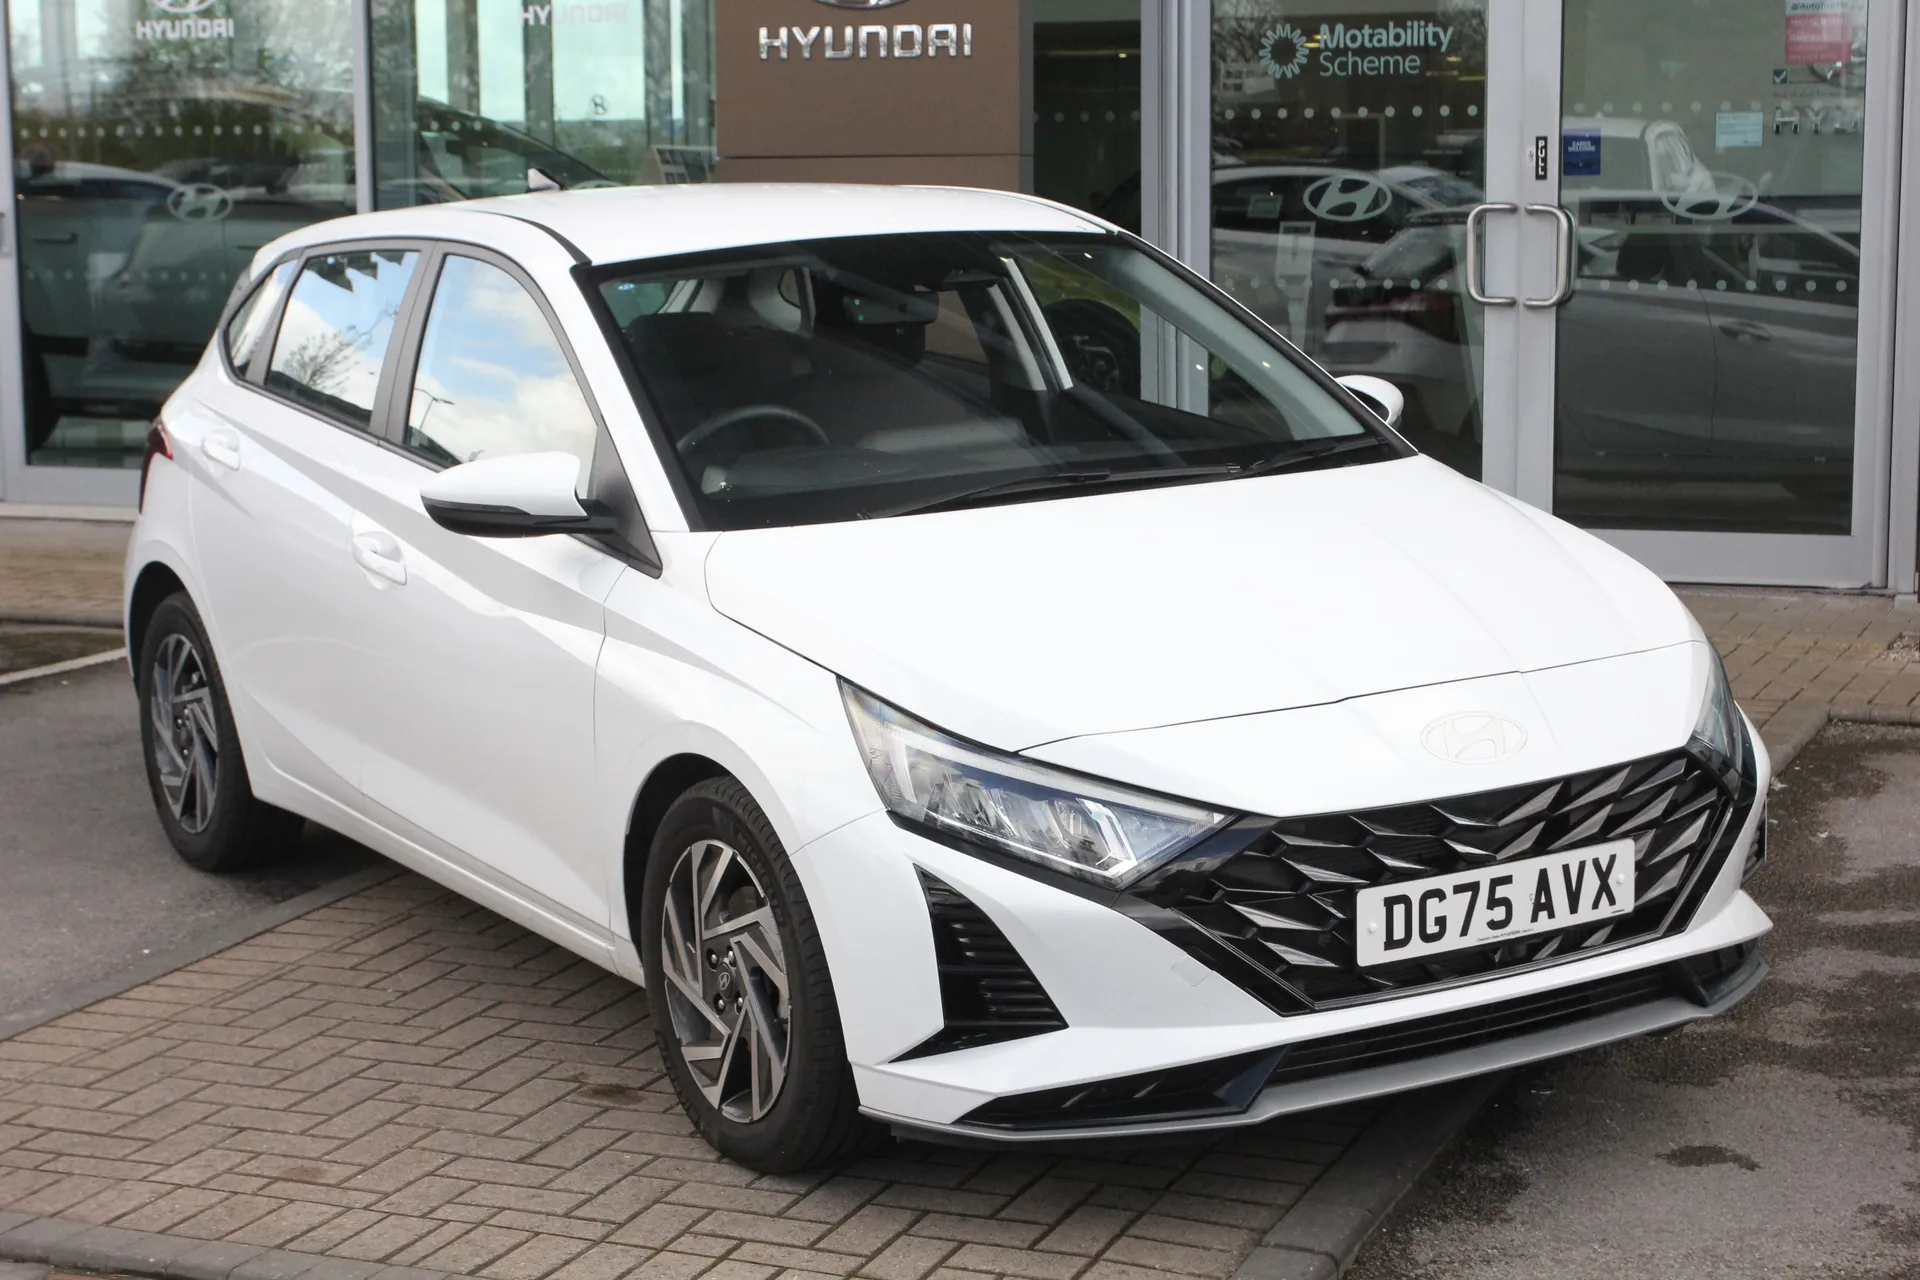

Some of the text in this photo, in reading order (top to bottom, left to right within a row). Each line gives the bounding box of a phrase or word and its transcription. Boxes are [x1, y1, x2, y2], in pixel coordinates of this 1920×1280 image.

[136, 18, 235, 40] HYUNDAI
[519, 3, 628, 26] HYUNDAI
[758, 23, 972, 60] HYUNDAI
[1319, 20, 1454, 52] Motability
[1319, 51, 1421, 76] Scheme
[1538, 139, 1546, 176] PULL
[1383, 853, 1617, 952] DG75 AVX
